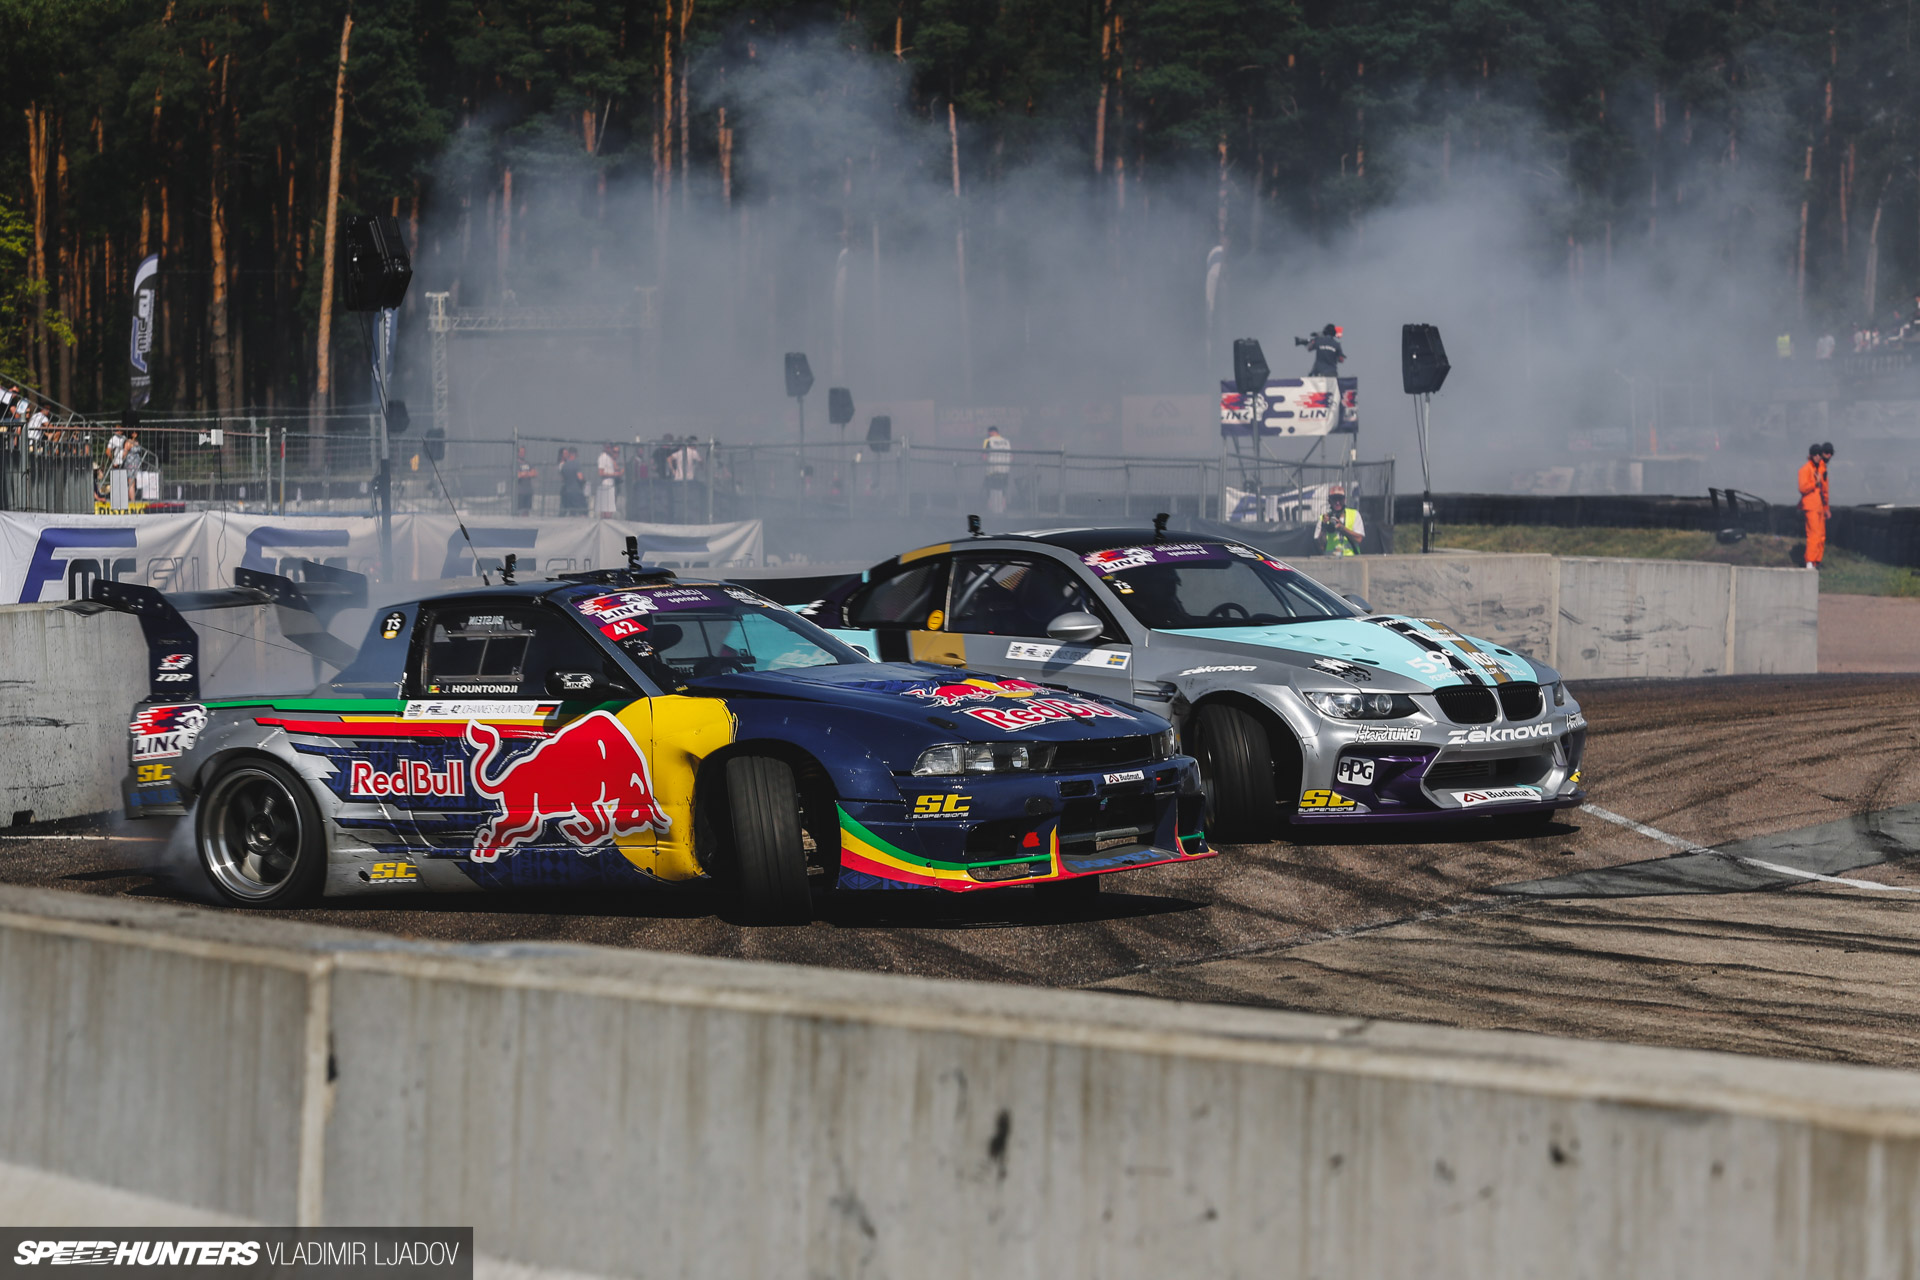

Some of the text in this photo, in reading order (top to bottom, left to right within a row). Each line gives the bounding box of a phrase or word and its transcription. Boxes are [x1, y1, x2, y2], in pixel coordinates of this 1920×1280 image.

[1102, 558, 1143, 570] LINK
[668, 596, 701, 604] sponsor
[600, 604, 644, 621] LINK
[612, 621, 640, 635] 42
[451, 685, 518, 694] HOUNTONDJI
[134, 735, 180, 754] LINK
[1339, 759, 1373, 782] PPG
